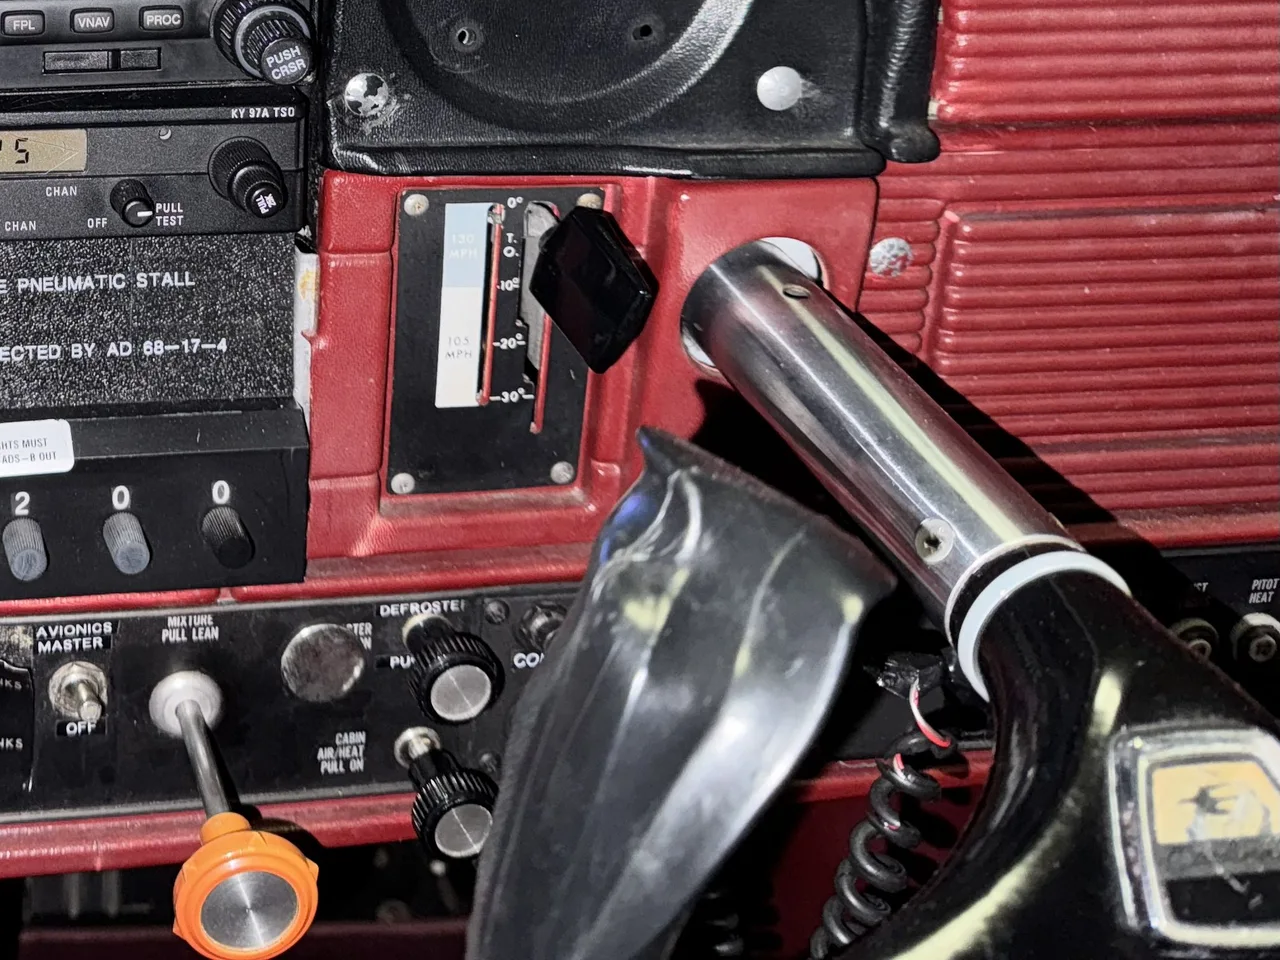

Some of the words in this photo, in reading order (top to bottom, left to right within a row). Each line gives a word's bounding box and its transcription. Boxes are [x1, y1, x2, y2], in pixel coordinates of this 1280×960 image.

[12, 20, 36, 31] FPL
[76, 16, 111, 29] VNAV
[145, 13, 182, 26] PROC
[230, 107, 246, 119] KY
[248, 107, 270, 119] 97A
[272, 106, 296, 118] TSO
[45, 185, 78, 198] CHAN
[155, 202, 184, 214] PULL
[4, 219, 37, 232] CHAN
[87, 217, 108, 230] OFF
[156, 214, 184, 227] TEST
[17, 273, 127, 292] PNEUMATIC
[136, 271, 196, 289] STALL
[71, 343, 96, 359] BY
[106, 341, 133, 357] AD
[22, 437, 48, 449] MUST
[38, 451, 58, 462] OUT
[1251, 578, 1280, 591] PITOT
[168, 614, 214, 628] MIXTURE
[36, 621, 113, 638] AVIONICS
[192, 626, 220, 641] LEAN
[38, 637, 104, 654] MASTER
[65, 722, 97, 736] OFF
[335, 731, 367, 744] CABIN
